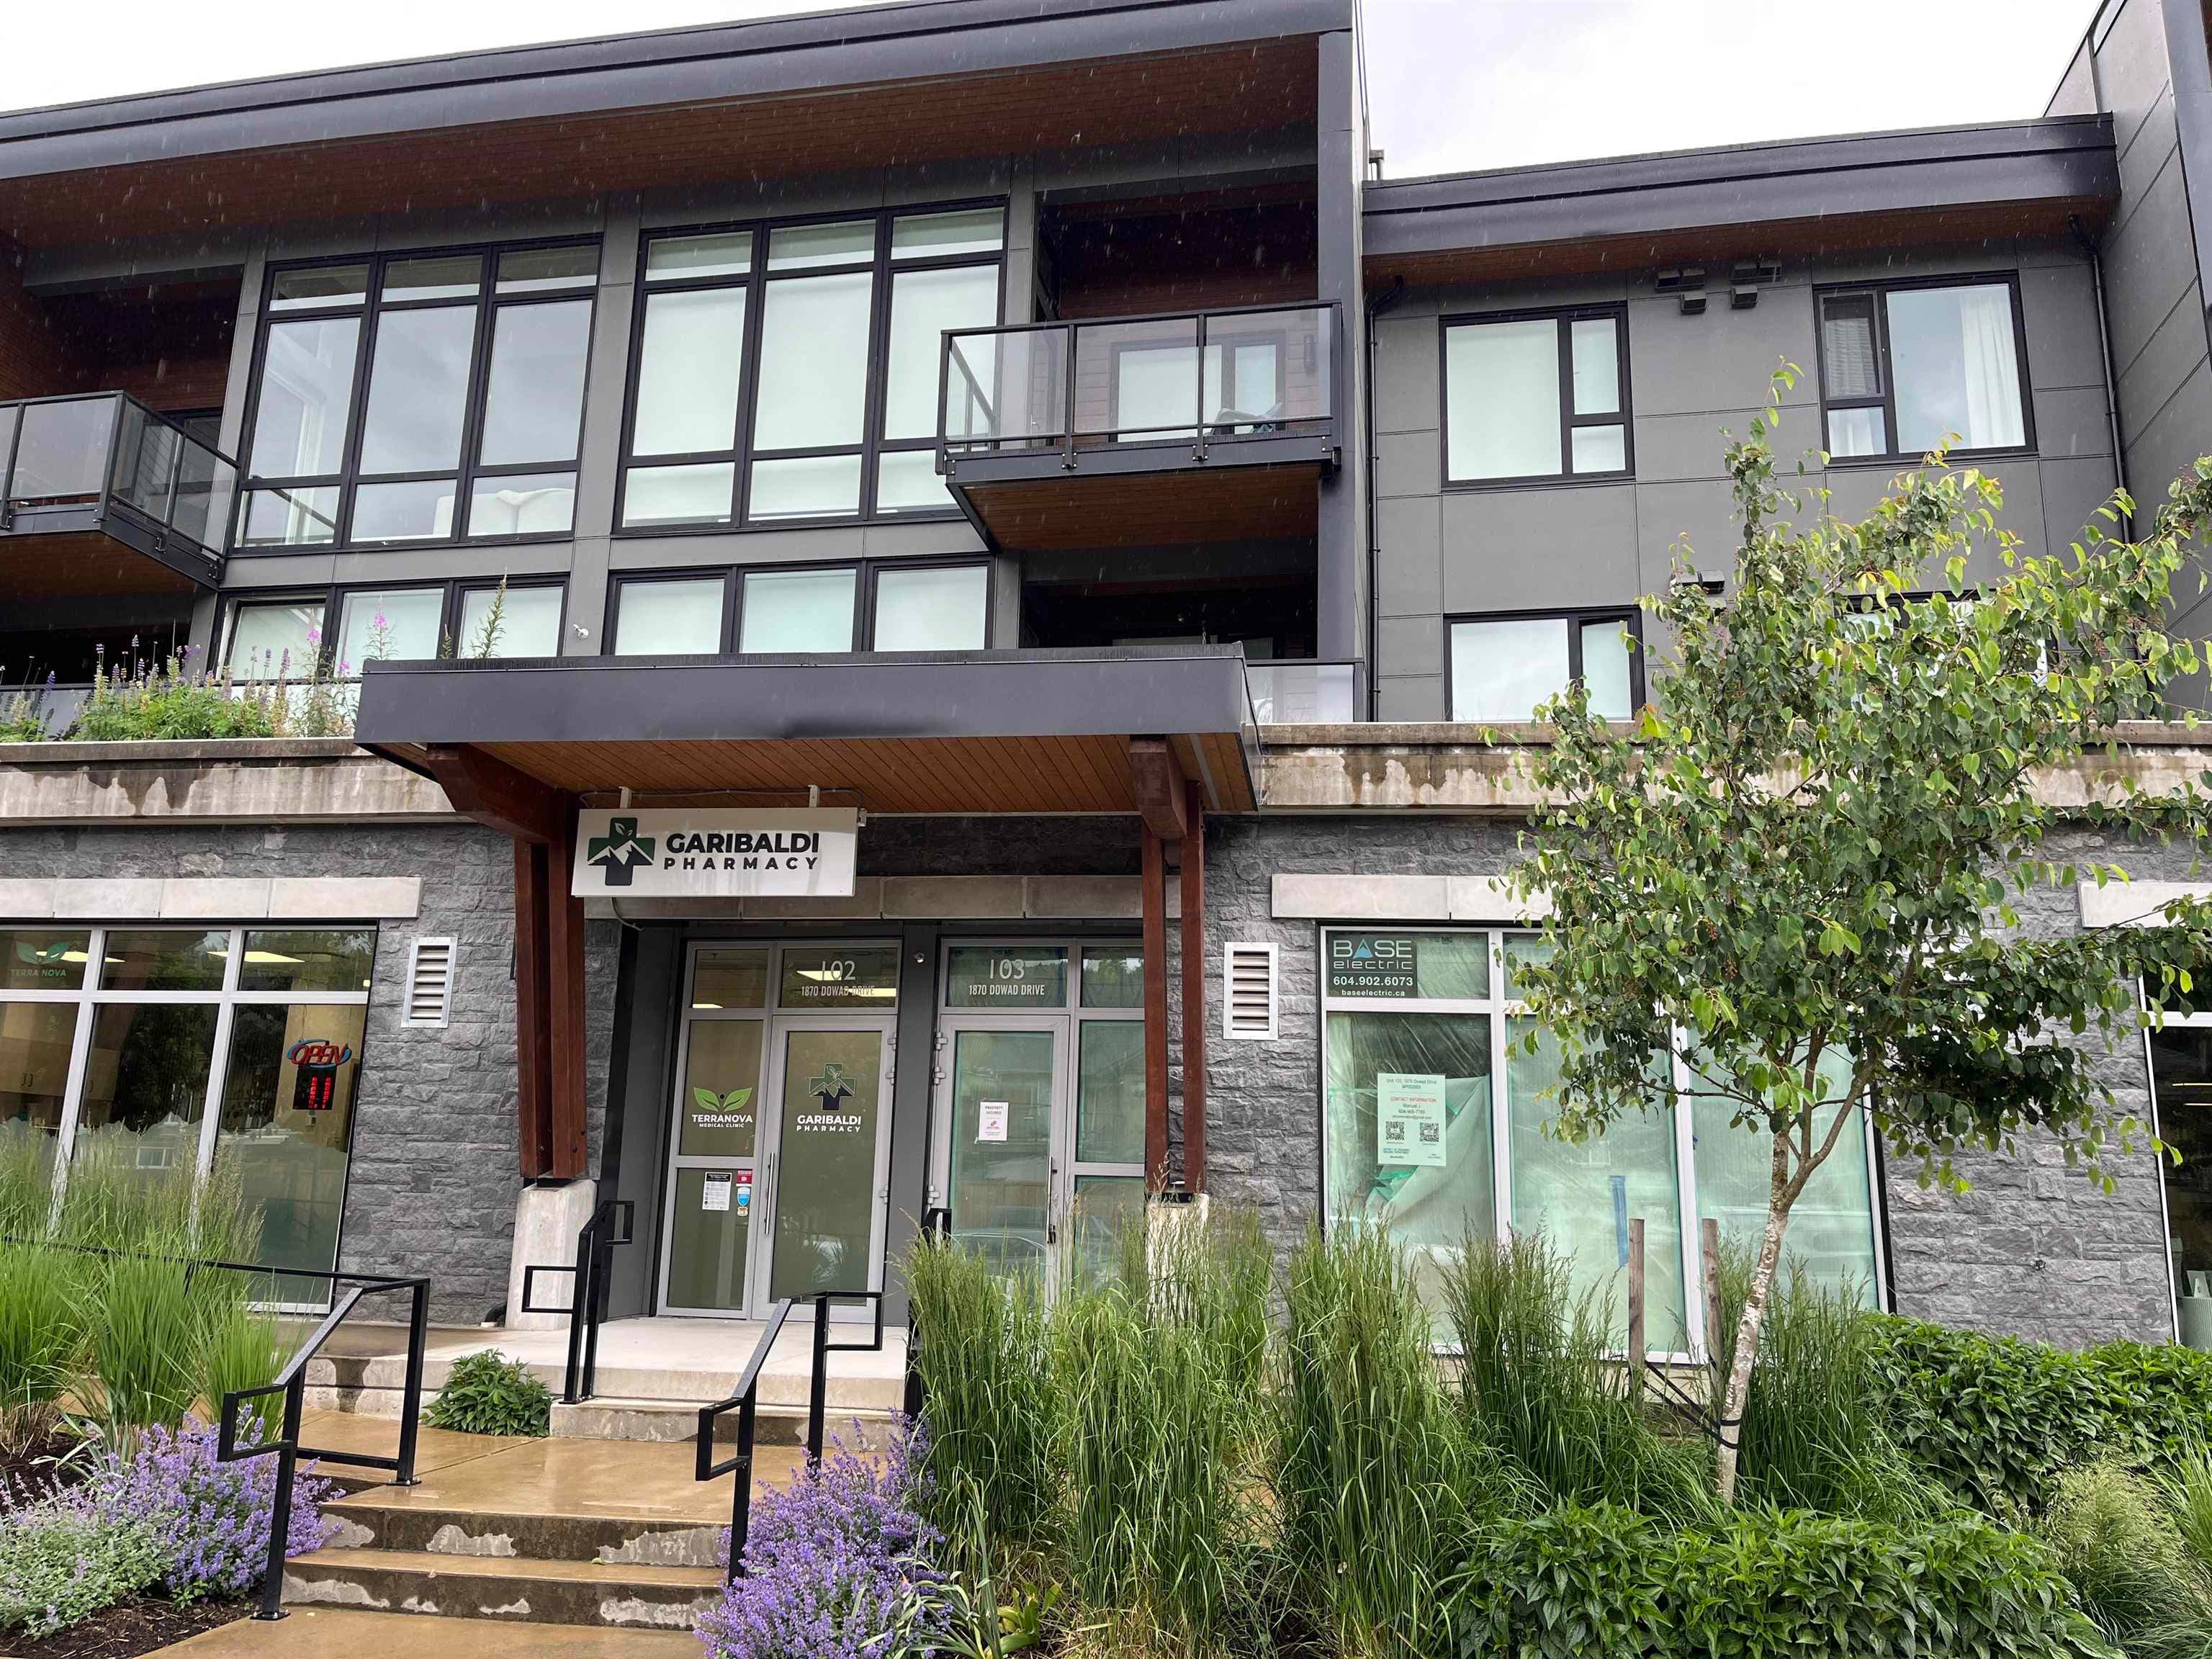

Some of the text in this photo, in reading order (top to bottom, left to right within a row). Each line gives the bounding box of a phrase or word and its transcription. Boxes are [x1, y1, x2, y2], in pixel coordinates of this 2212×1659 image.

[666, 832, 819, 853] GARIBALDI
[664, 857, 819, 871] PHARMACY
[1334, 939, 1412, 958] BASE
[822, 961, 855, 981] 102
[990, 958, 1025, 979] 103
[1334, 959, 1412, 969] electric
[1334, 976, 1413, 986] 604.902.6073
[801, 986, 875, 997] 1870 DOWAD DRIVE
[968, 985, 1045, 995] 1870 DOWAD DRIVE
[290, 1043, 349, 1066] OPEN
[797, 1115, 861, 1125] GARIBALDI
